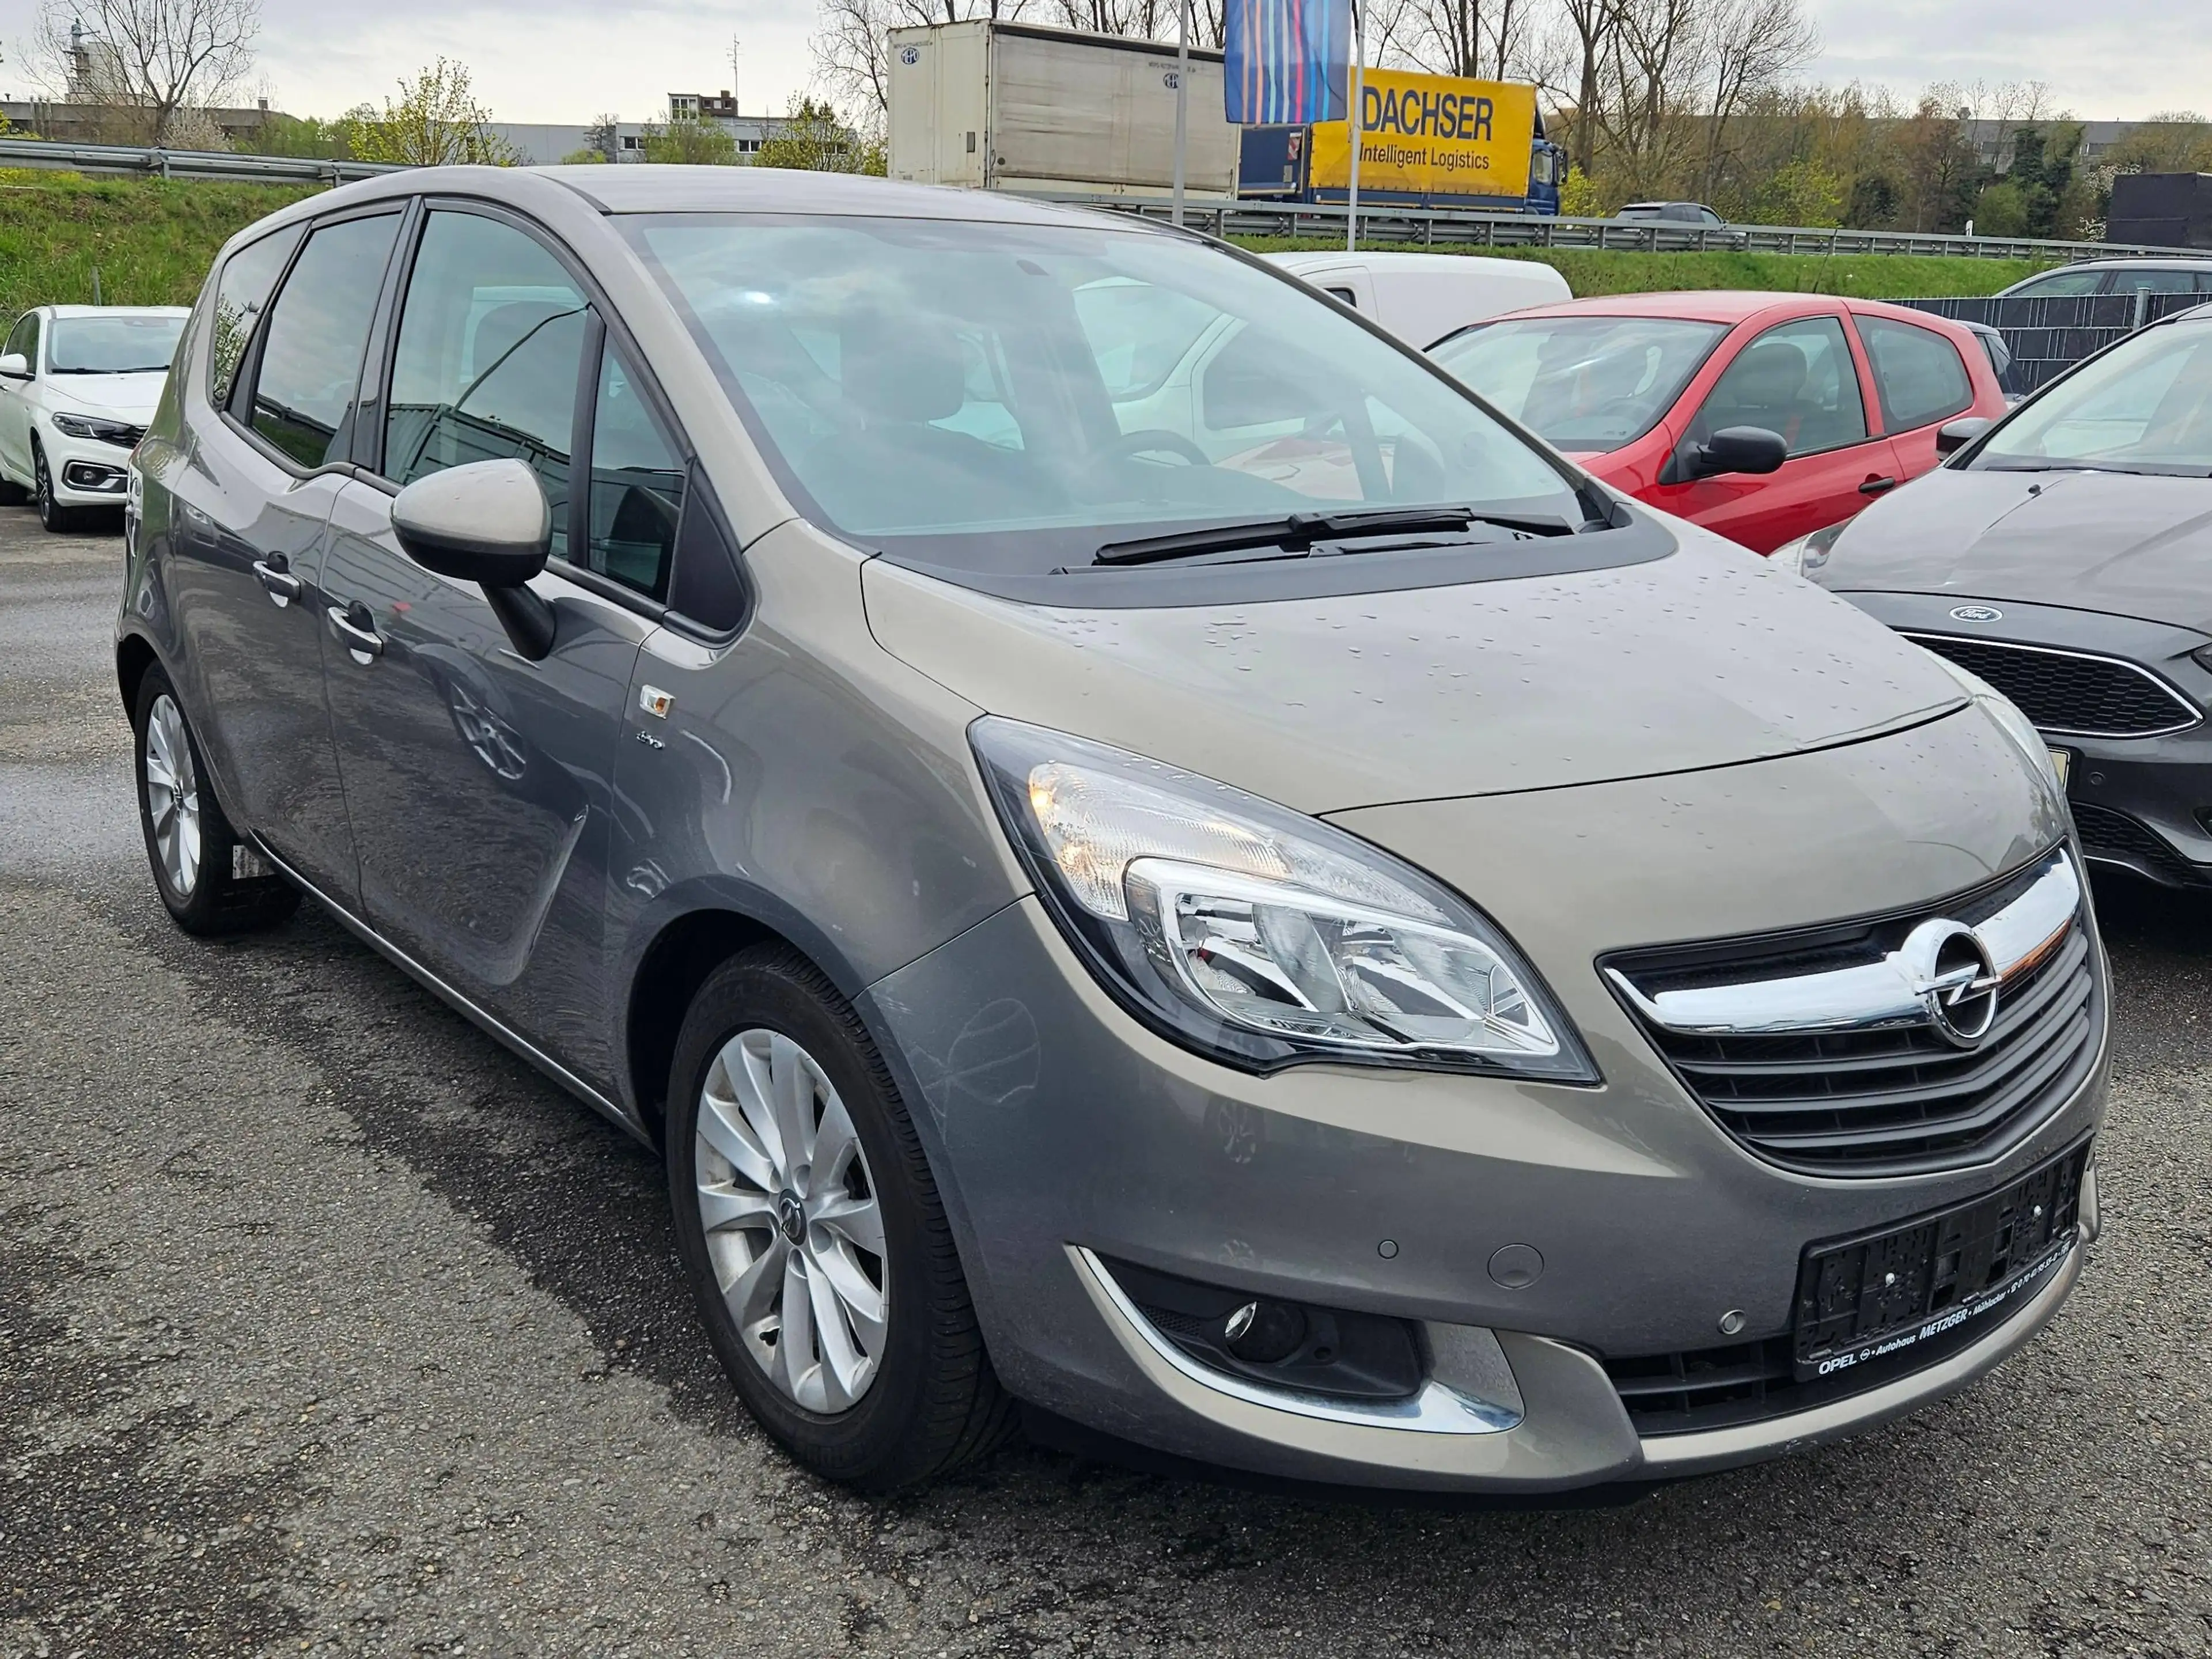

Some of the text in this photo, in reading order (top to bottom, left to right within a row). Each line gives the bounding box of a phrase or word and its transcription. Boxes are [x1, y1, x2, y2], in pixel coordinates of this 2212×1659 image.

[1362, 85, 1494, 141] DACHSER
[1359, 143, 1490, 172] Intelligent Logistics
[1959, 608, 1991, 619] Ford
[1819, 1353, 1857, 1375] OPEL
[1876, 1335, 1916, 1356] Autohaus
[1919, 1308, 1968, 1340] METZGER
